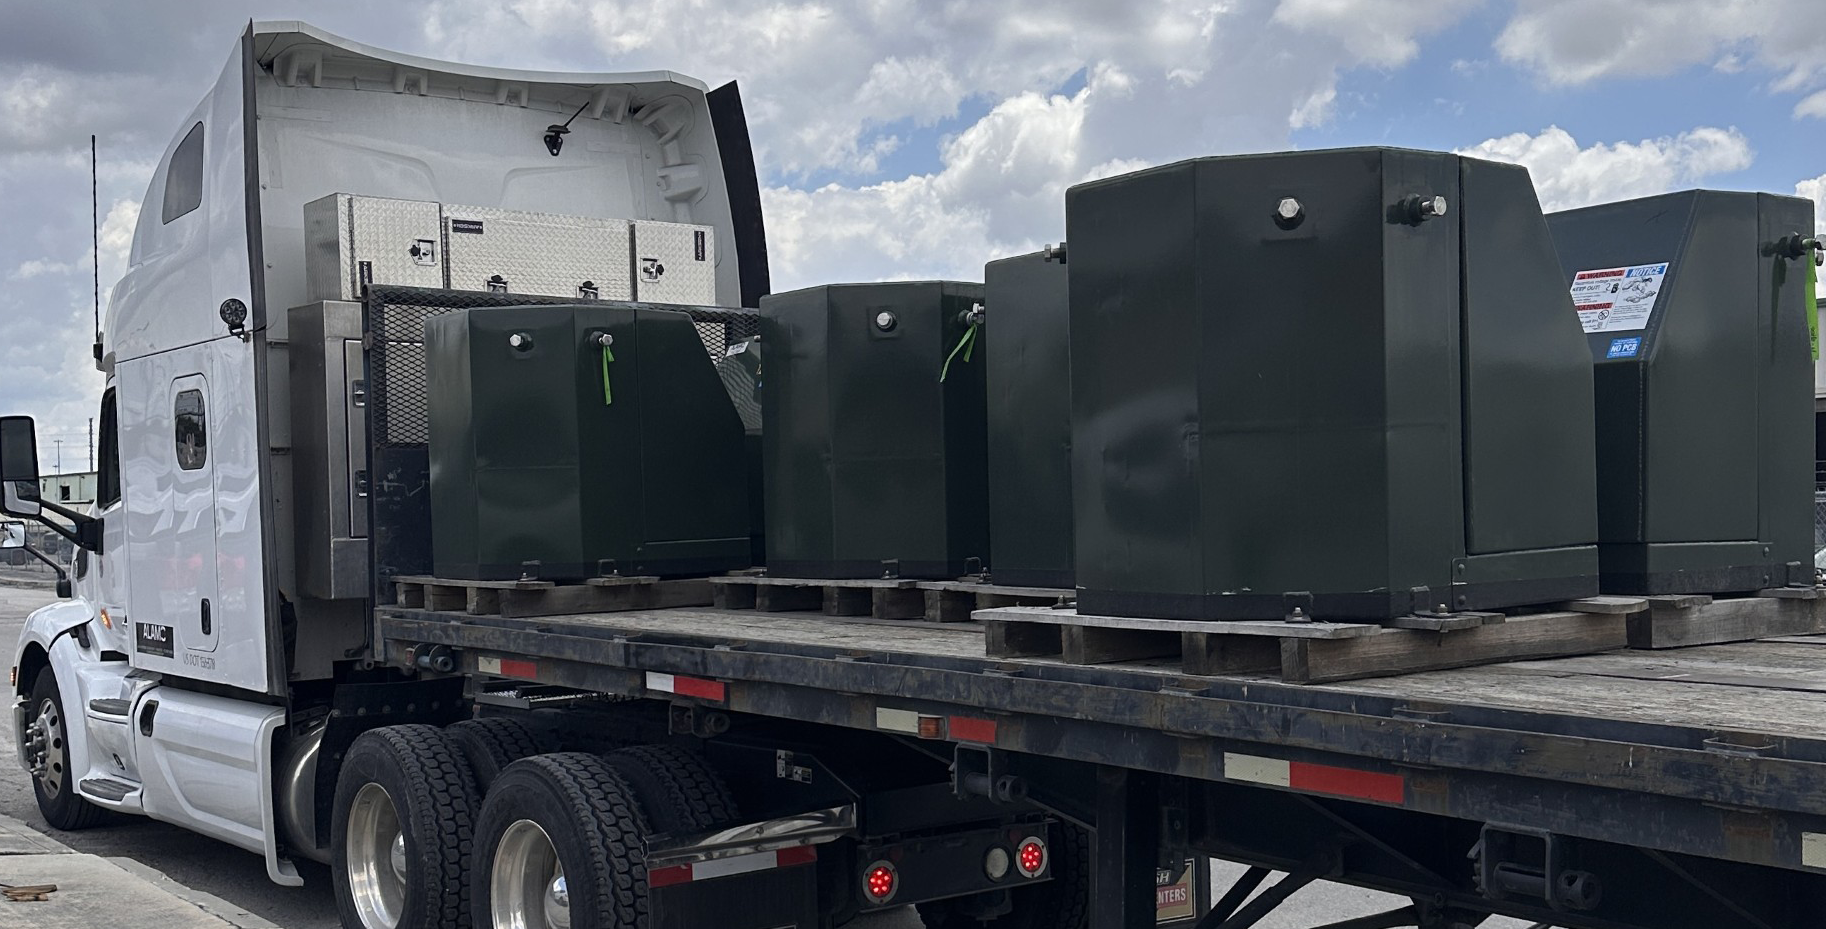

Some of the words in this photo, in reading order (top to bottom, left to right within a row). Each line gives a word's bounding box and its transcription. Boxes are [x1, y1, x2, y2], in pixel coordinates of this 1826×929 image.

[1629, 266, 1662, 277] NOTICE
[1610, 345, 1621, 353] NO
[1622, 343, 1637, 352] PCB
